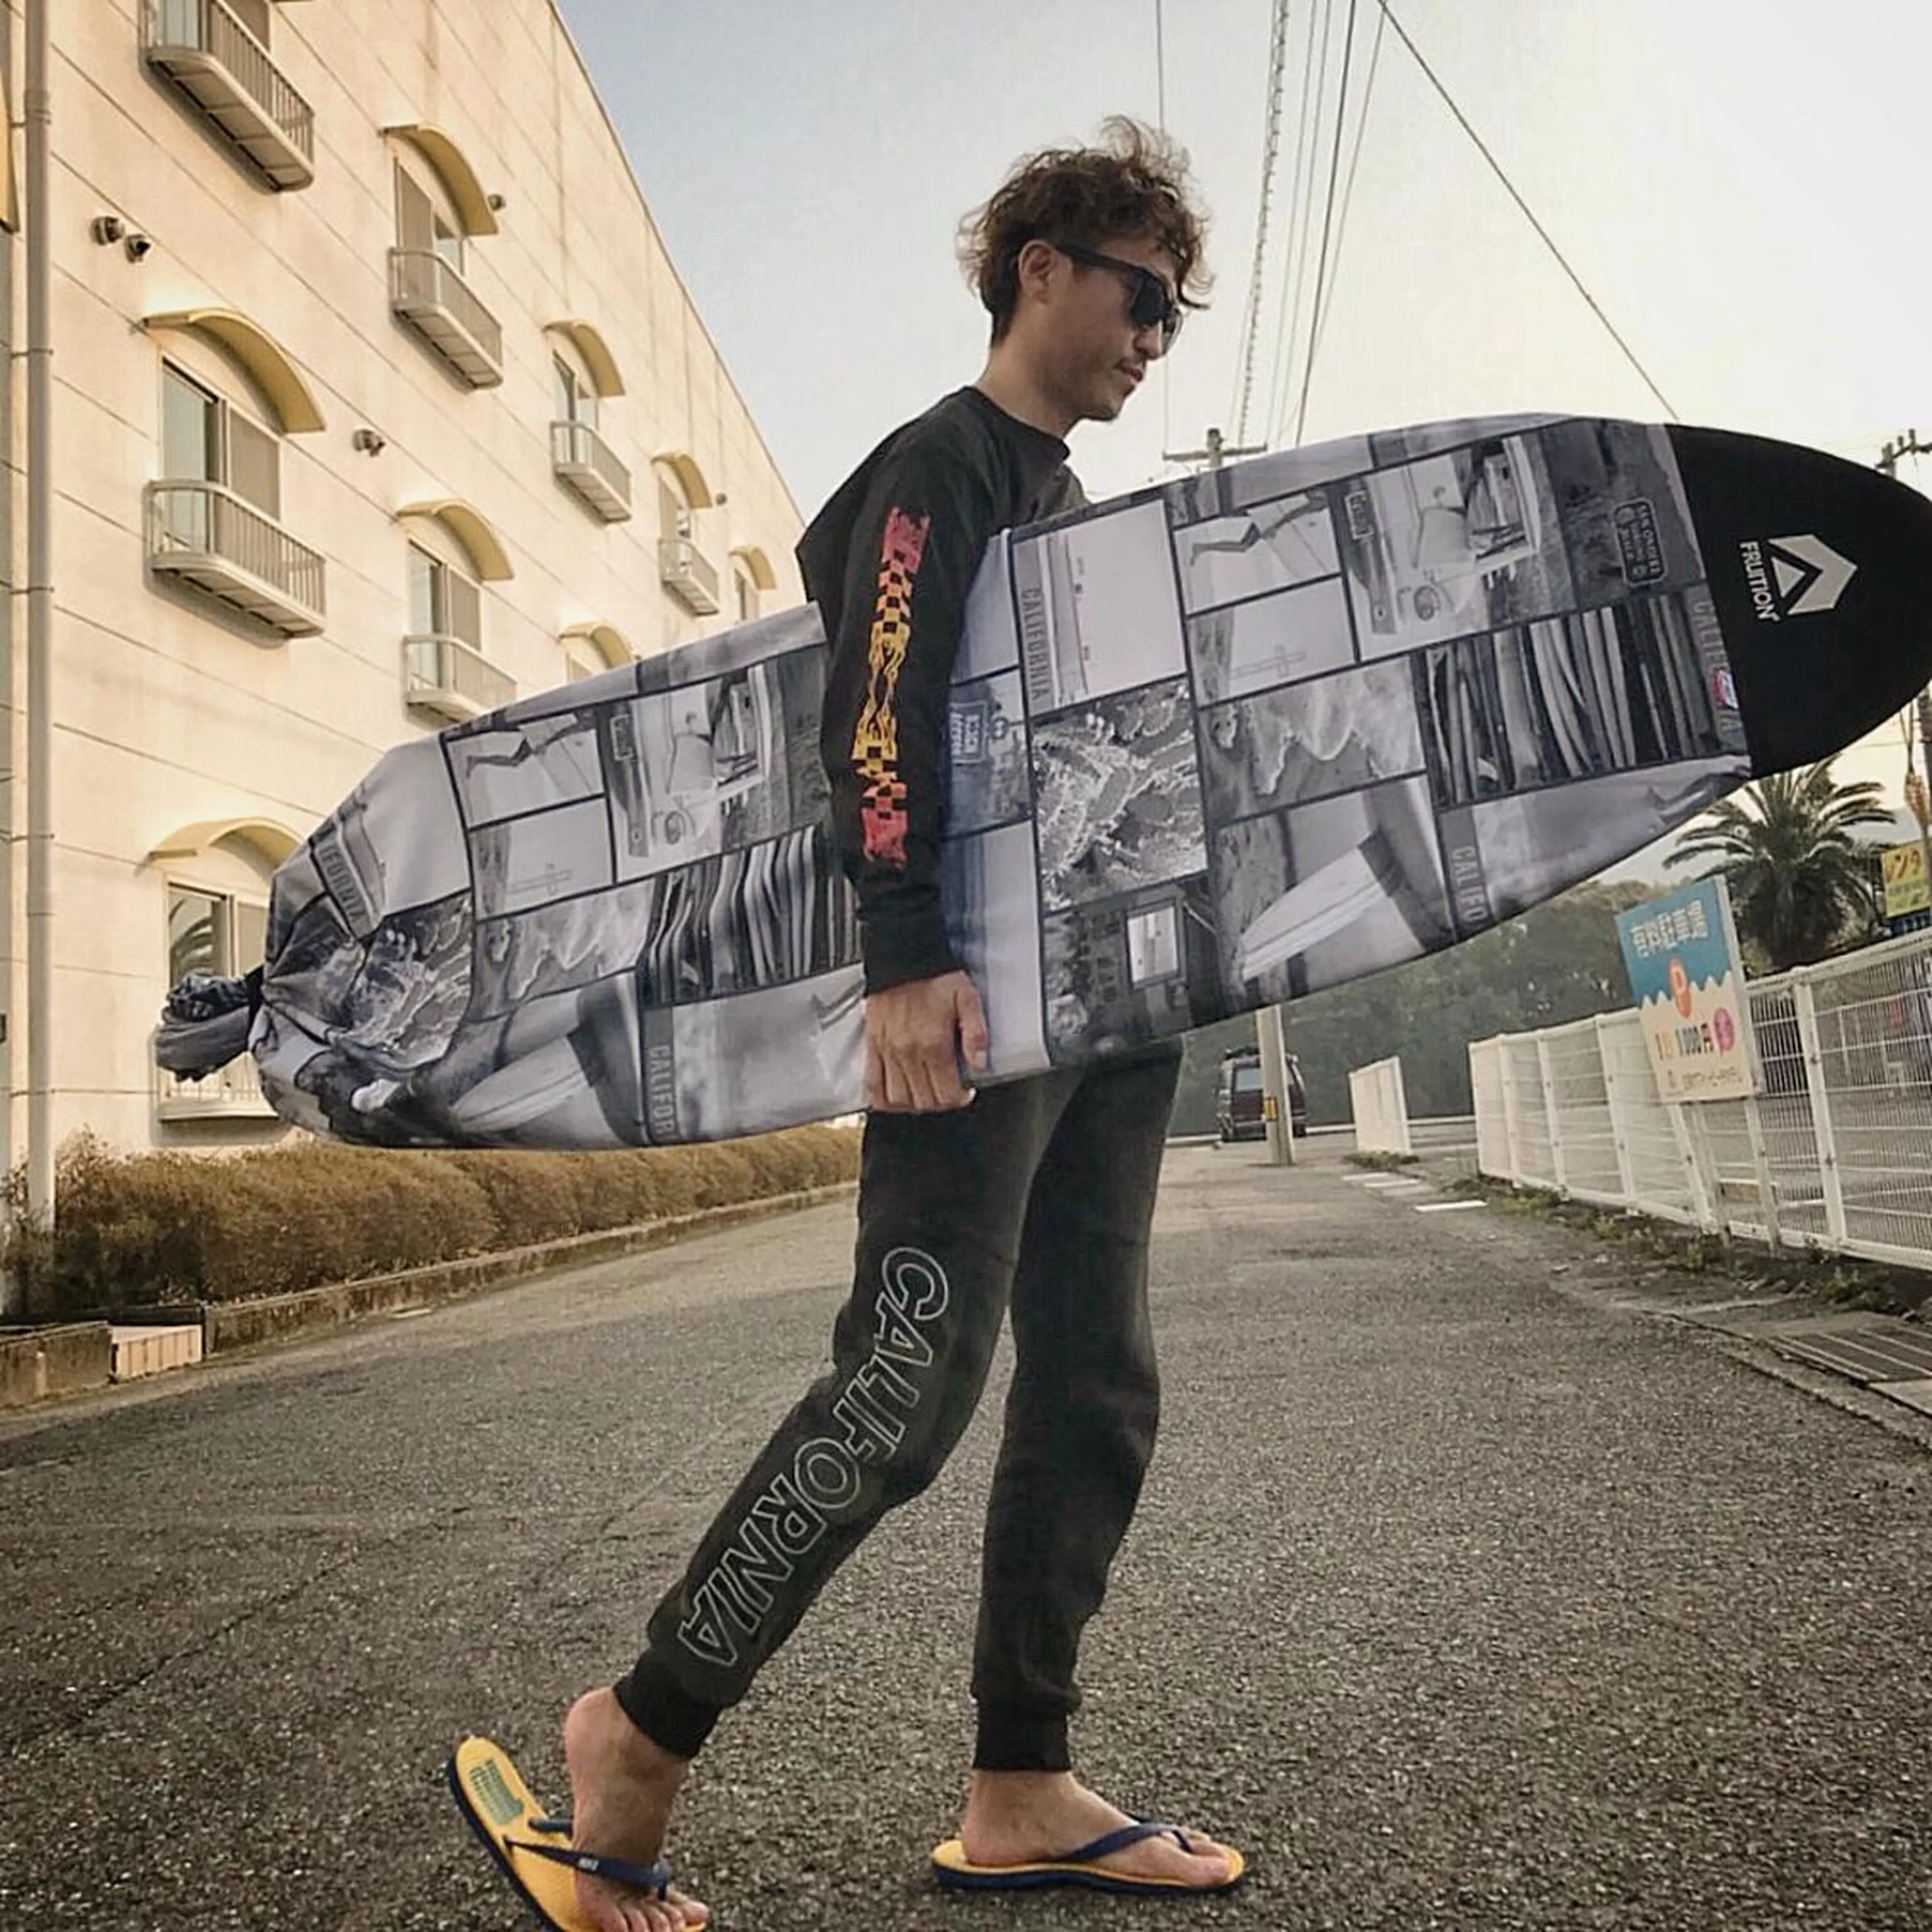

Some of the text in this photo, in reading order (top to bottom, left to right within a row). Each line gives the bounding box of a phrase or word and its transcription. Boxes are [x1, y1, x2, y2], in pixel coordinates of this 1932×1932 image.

[1739, 541, 1779, 621] FRUITION
[1022, 587, 1051, 700] CALIFORNIA
[677, 1247, 949, 1667] CALIFORNIA
